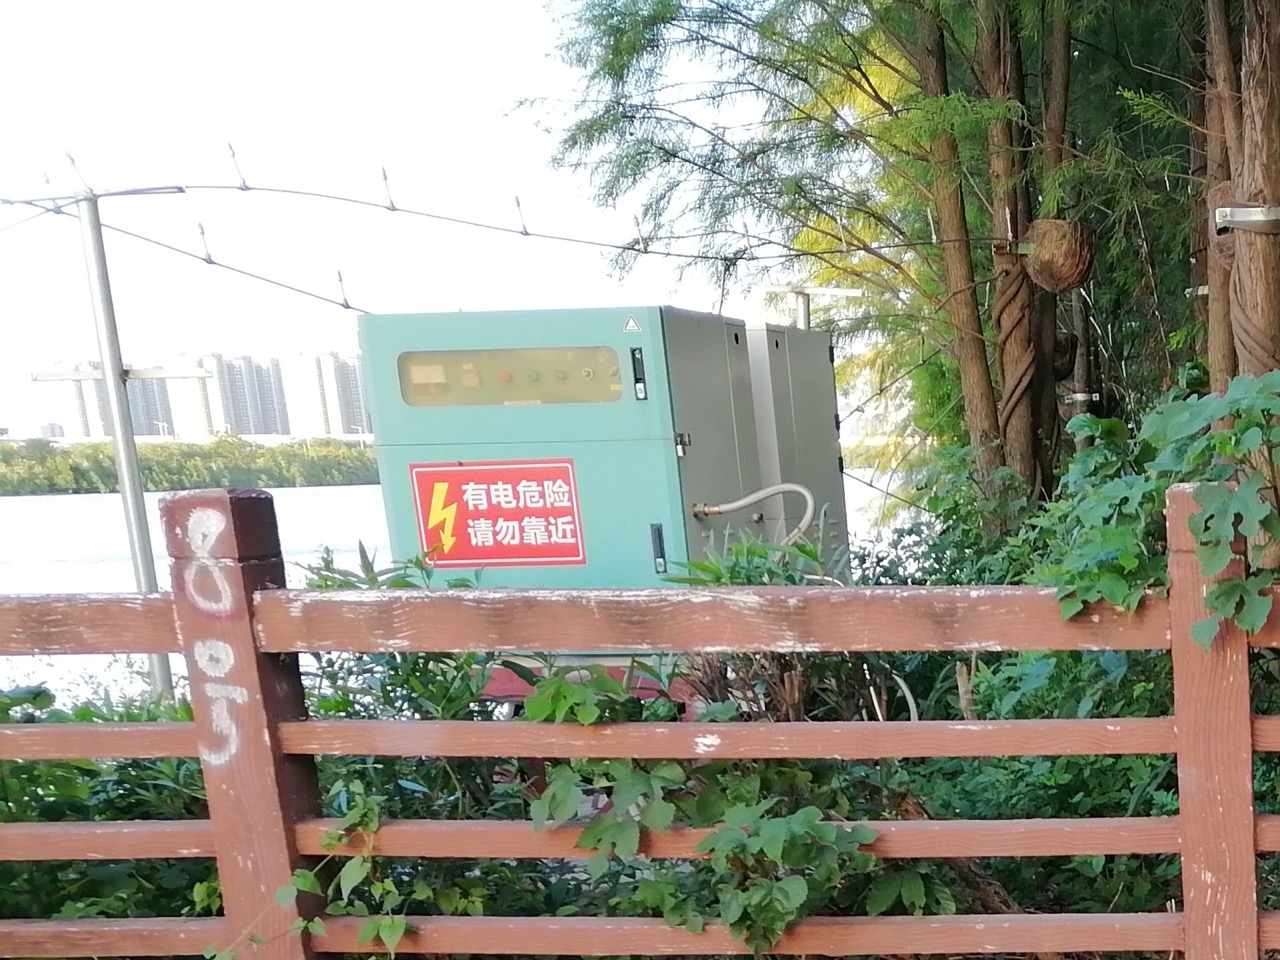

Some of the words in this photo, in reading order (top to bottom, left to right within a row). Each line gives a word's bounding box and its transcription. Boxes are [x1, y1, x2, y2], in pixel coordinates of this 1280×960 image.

[461, 479, 571, 510] 有电危险
[467, 515, 576, 546] 请勿靠近
